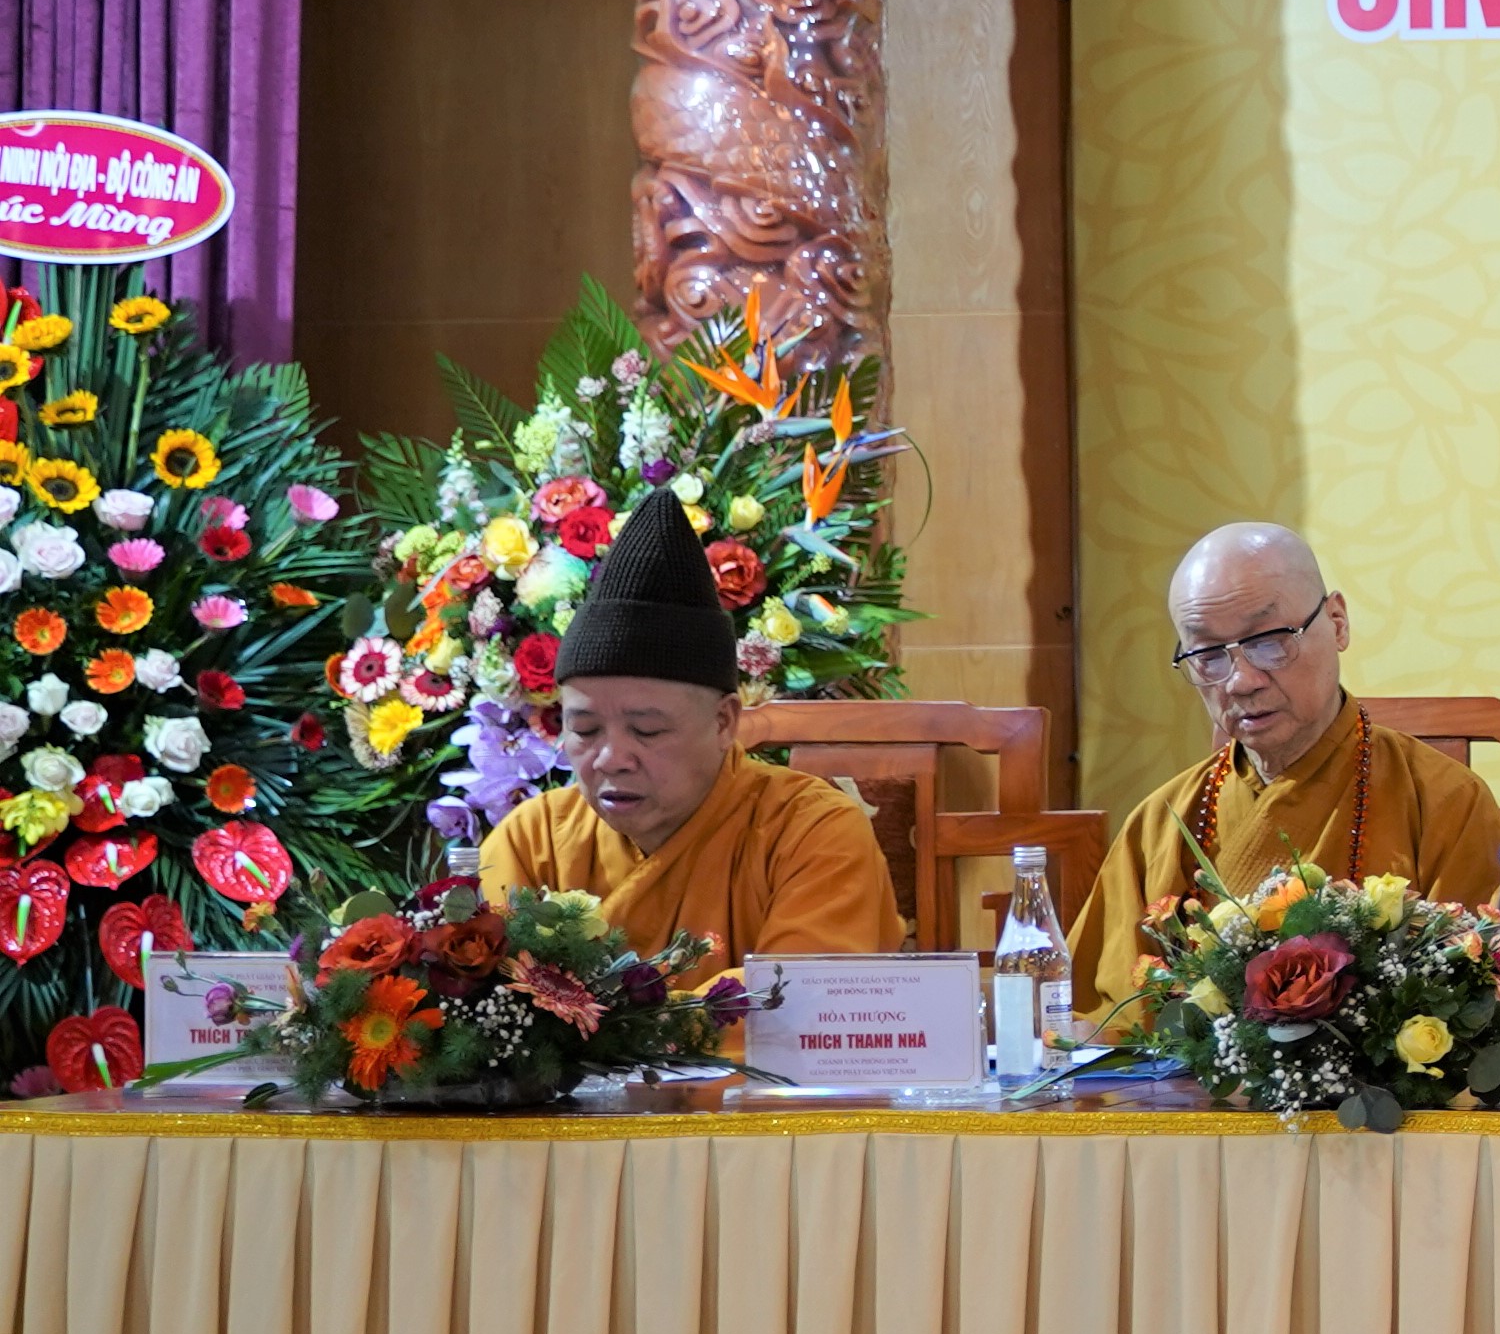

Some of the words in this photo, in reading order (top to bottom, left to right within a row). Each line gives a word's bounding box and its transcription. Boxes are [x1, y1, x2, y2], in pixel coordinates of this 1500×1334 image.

[38, 141, 70, 196] NỘI
[105, 149, 131, 203] BỘ
[130, 152, 176, 201] CÔNG
[173, 165, 200, 203] AN
[50, 201, 174, 245] Mừng
[819, 1010, 846, 1022] HÒA
[849, 1011, 906, 1024] THƯỢNG
[190, 1027, 230, 1044] THÍCH
[799, 1031, 841, 1049] THÍCH
[846, 1033, 892, 1049] THANH
